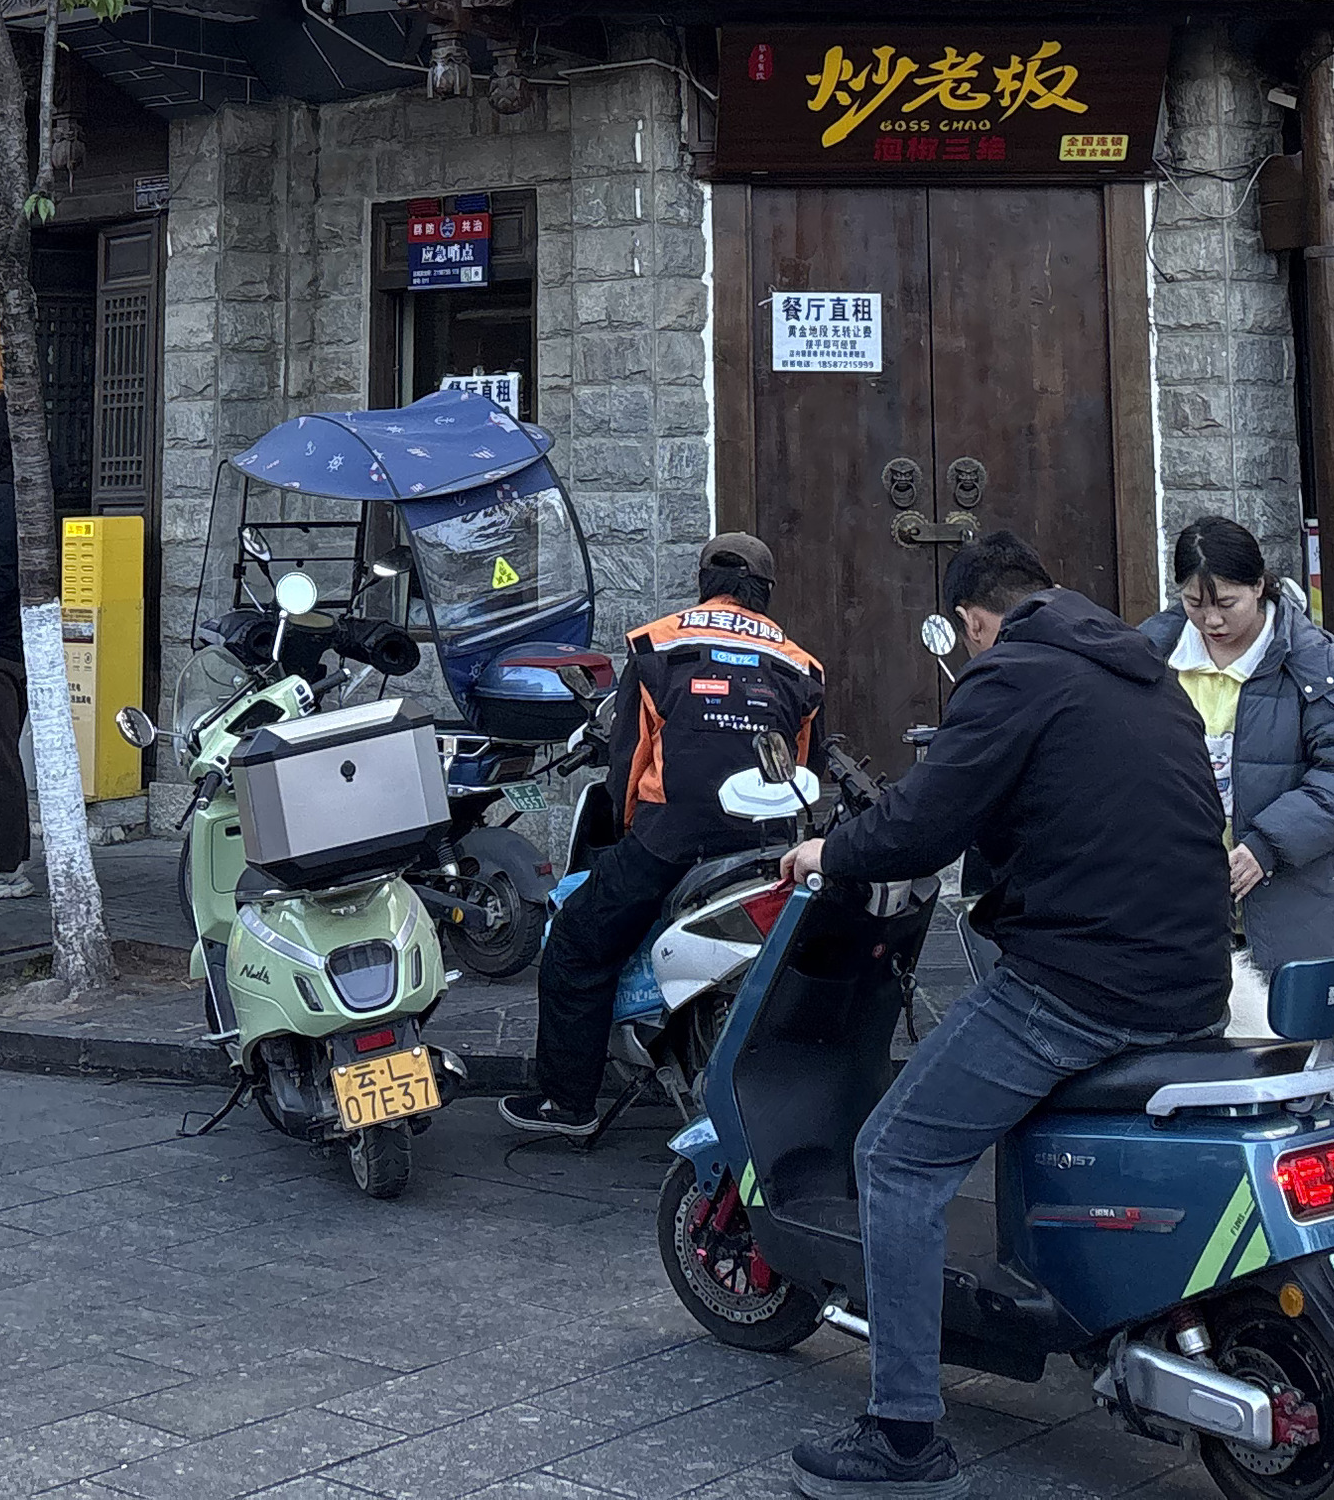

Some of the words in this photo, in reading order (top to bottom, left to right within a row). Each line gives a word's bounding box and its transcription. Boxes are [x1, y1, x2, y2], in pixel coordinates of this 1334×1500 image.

[806, 41, 1089, 148] 炒老板
[879, 118, 930, 132] BOSS
[939, 118, 992, 131] CHAO
[1066, 136, 1124, 147] 全国连锁
[873, 137, 1007, 162] 泡椒三绝
[1063, 147, 1123, 158] 大理古城店
[462, 219, 483, 233] 共治
[421, 243, 475, 264] 应急哨点
[782, 296, 873, 322] 餐厅直租
[787, 325, 828, 338] 黄金地段
[831, 325, 873, 339] 无转让费
[805, 339, 858, 350] 接手即可经营
[682, 610, 784, 643] 淘宝闪购
[344, 1078, 438, 1126] 07E37
[1089, 1208, 1115, 1218] CHINA
